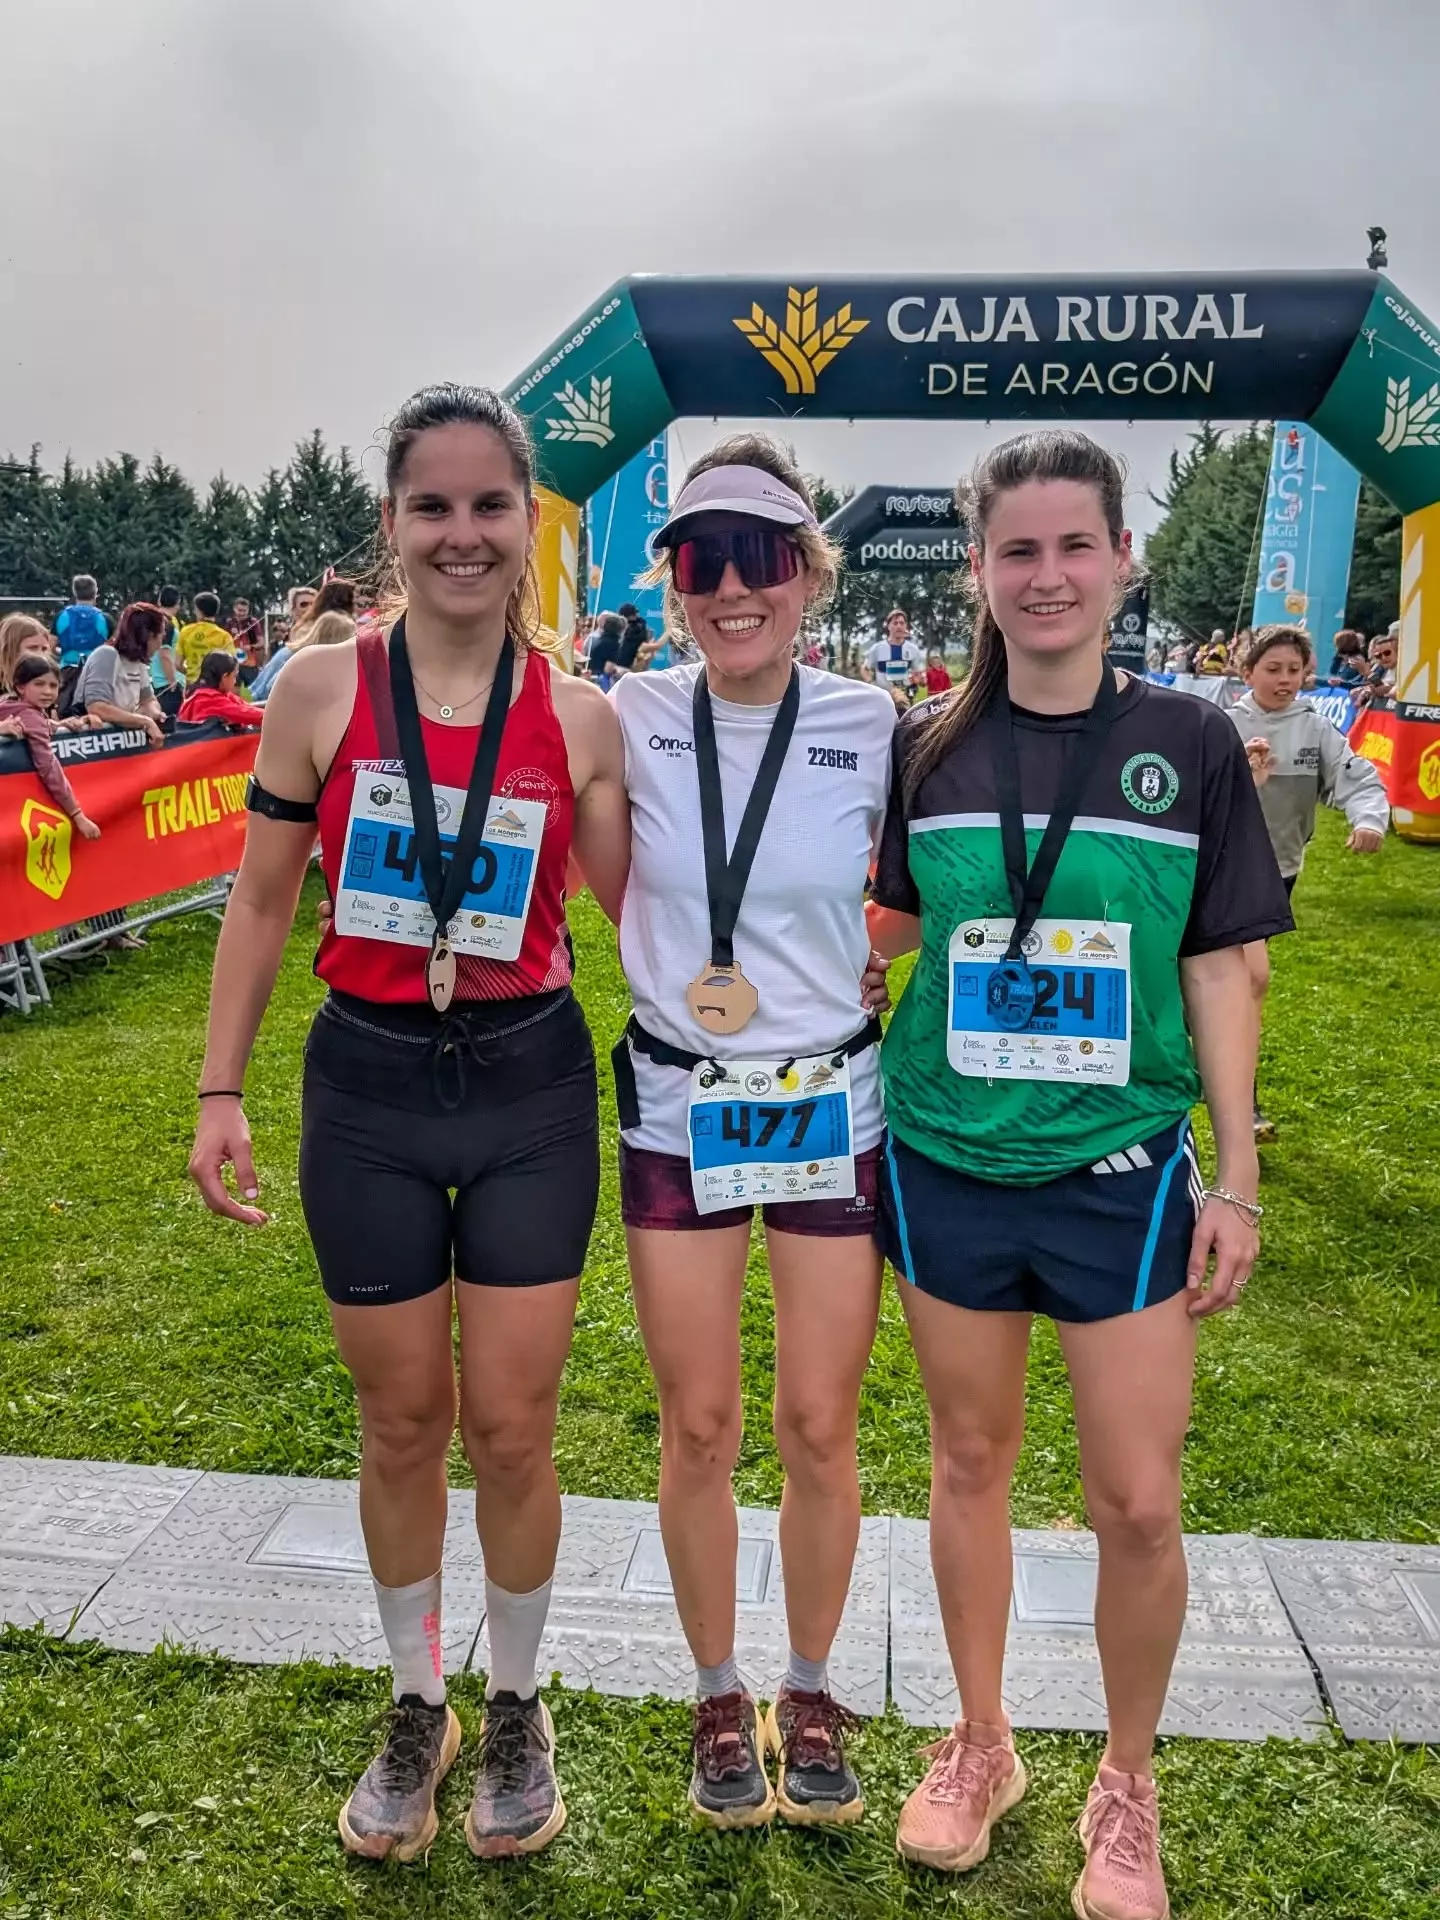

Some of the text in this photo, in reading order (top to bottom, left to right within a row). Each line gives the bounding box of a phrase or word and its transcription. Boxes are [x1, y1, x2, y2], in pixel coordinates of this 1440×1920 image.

[887, 293, 1264, 343] CAJA RURAL
[928, 352, 1214, 396] DE ARAGÓN
[885, 494, 952, 513] raster
[860, 537, 970, 567] podoactiv
[1404, 703, 1440, 720] FIRE
[807, 747, 858, 771] 226ERS
[1123, 754, 1178, 785] ATLETISMO
[518, 780, 547, 791] GENTE
[142, 777, 221, 840] TRAIL
[721, 1101, 819, 1148] 477
[349, 1284, 390, 1292] EVADICT
